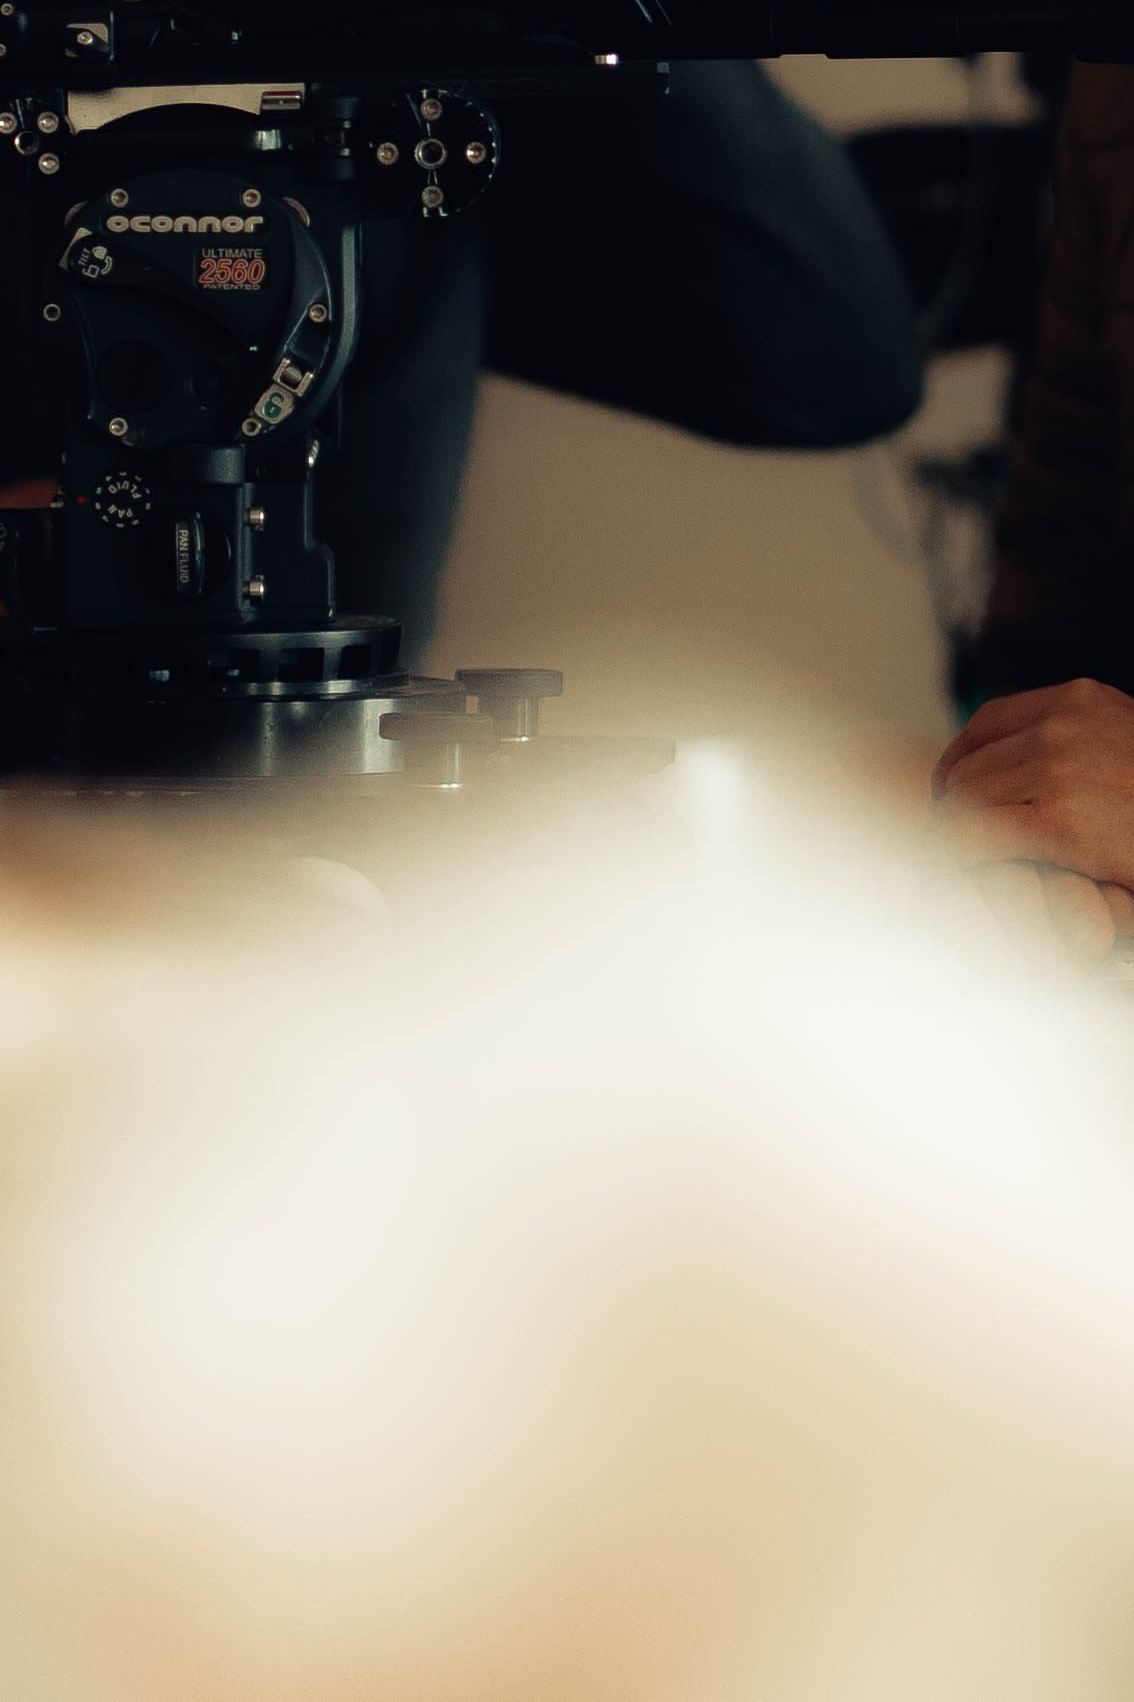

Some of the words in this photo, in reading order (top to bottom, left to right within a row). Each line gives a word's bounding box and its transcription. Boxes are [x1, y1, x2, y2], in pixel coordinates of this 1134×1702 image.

[106, 215, 264, 233] oconnor
[202, 248, 263, 259] ULTIMATE
[198, 258, 265, 285] 2560
[107, 504, 134, 519] PAN
[179, 529, 189, 551] PAN
[179, 553, 190, 584] FLUID
